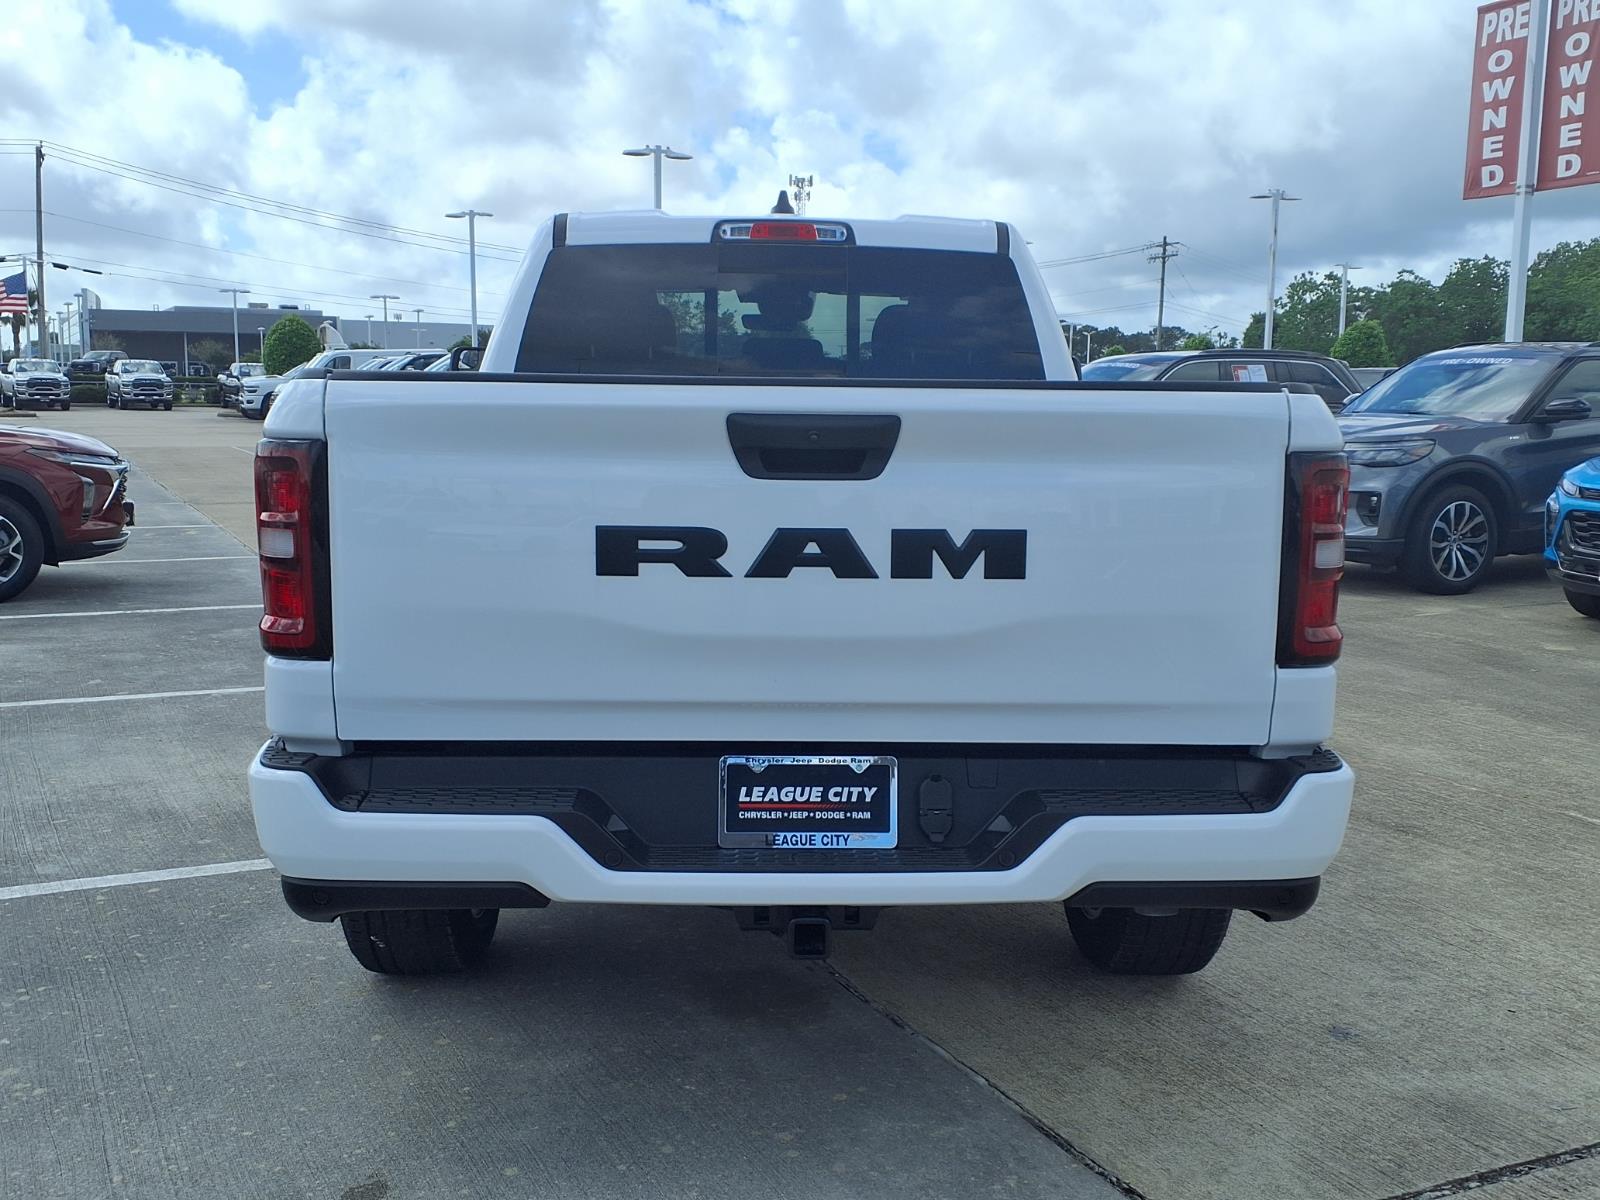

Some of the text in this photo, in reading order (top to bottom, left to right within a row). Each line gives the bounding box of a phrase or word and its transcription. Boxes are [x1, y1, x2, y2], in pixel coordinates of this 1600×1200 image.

[1481, 3, 1530, 47] PRE
[1481, 49, 1515, 188] OWNED
[1556, 31, 1592, 178] OWNED
[595, 525, 1028, 579] RAM
[745, 757, 784, 765] Chrysler
[738, 786, 877, 802] LEAGUE CITY
[738, 811, 871, 819] CHRYSLER JEEP DODGE RAM
[765, 834, 850, 846] LEAGUE CITY
